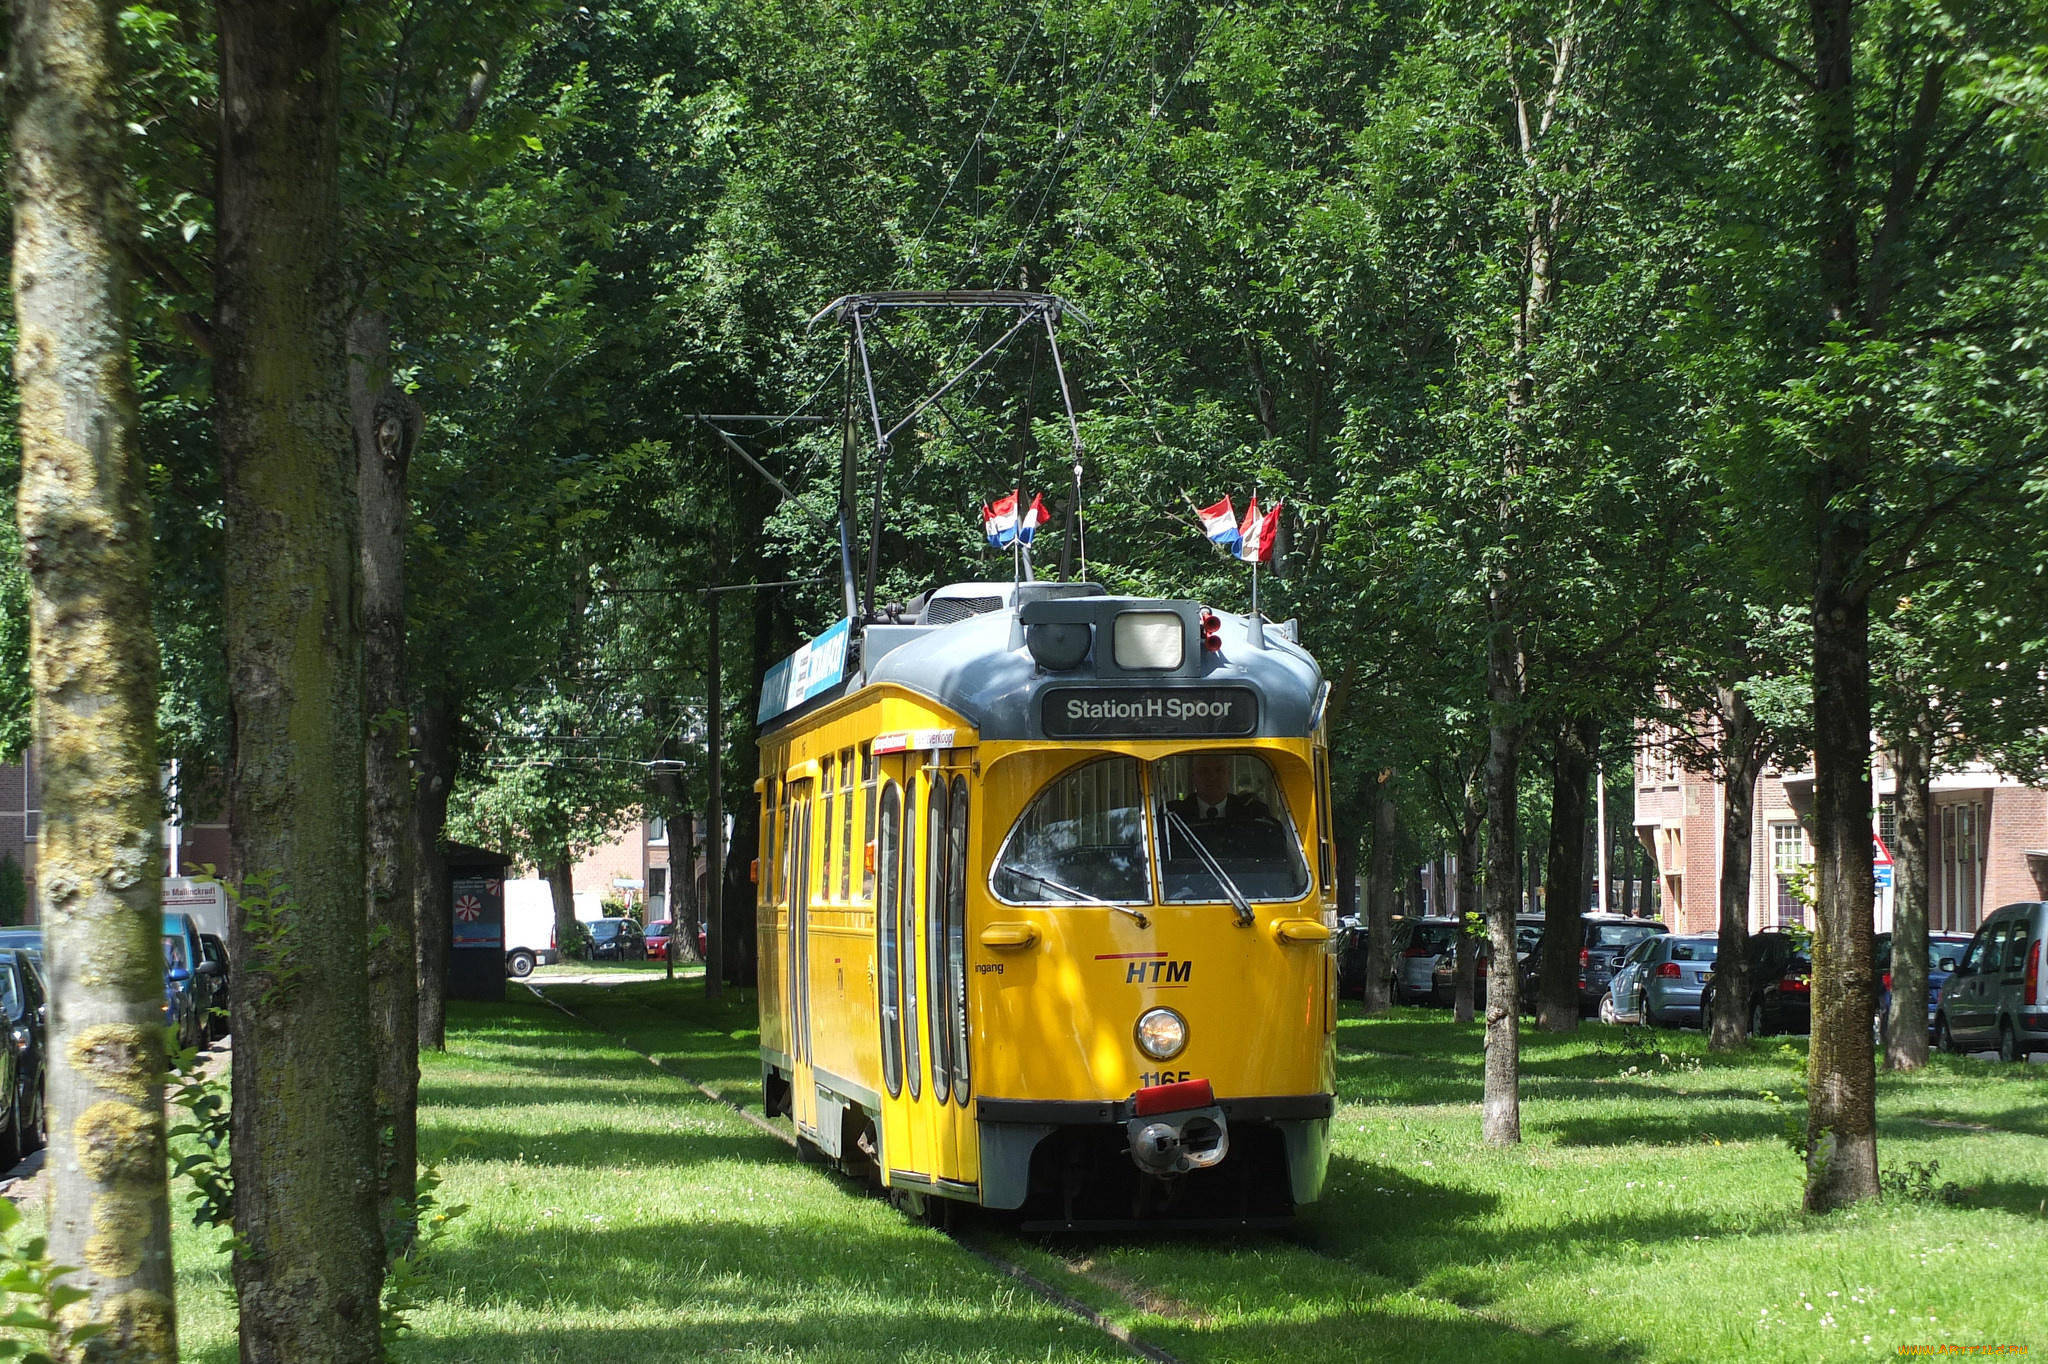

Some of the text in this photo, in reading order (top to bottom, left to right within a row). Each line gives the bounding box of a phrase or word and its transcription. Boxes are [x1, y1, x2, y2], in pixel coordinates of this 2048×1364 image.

[1067, 698, 1232, 720] Station H Spoor
[1126, 961, 1192, 983] HTM
